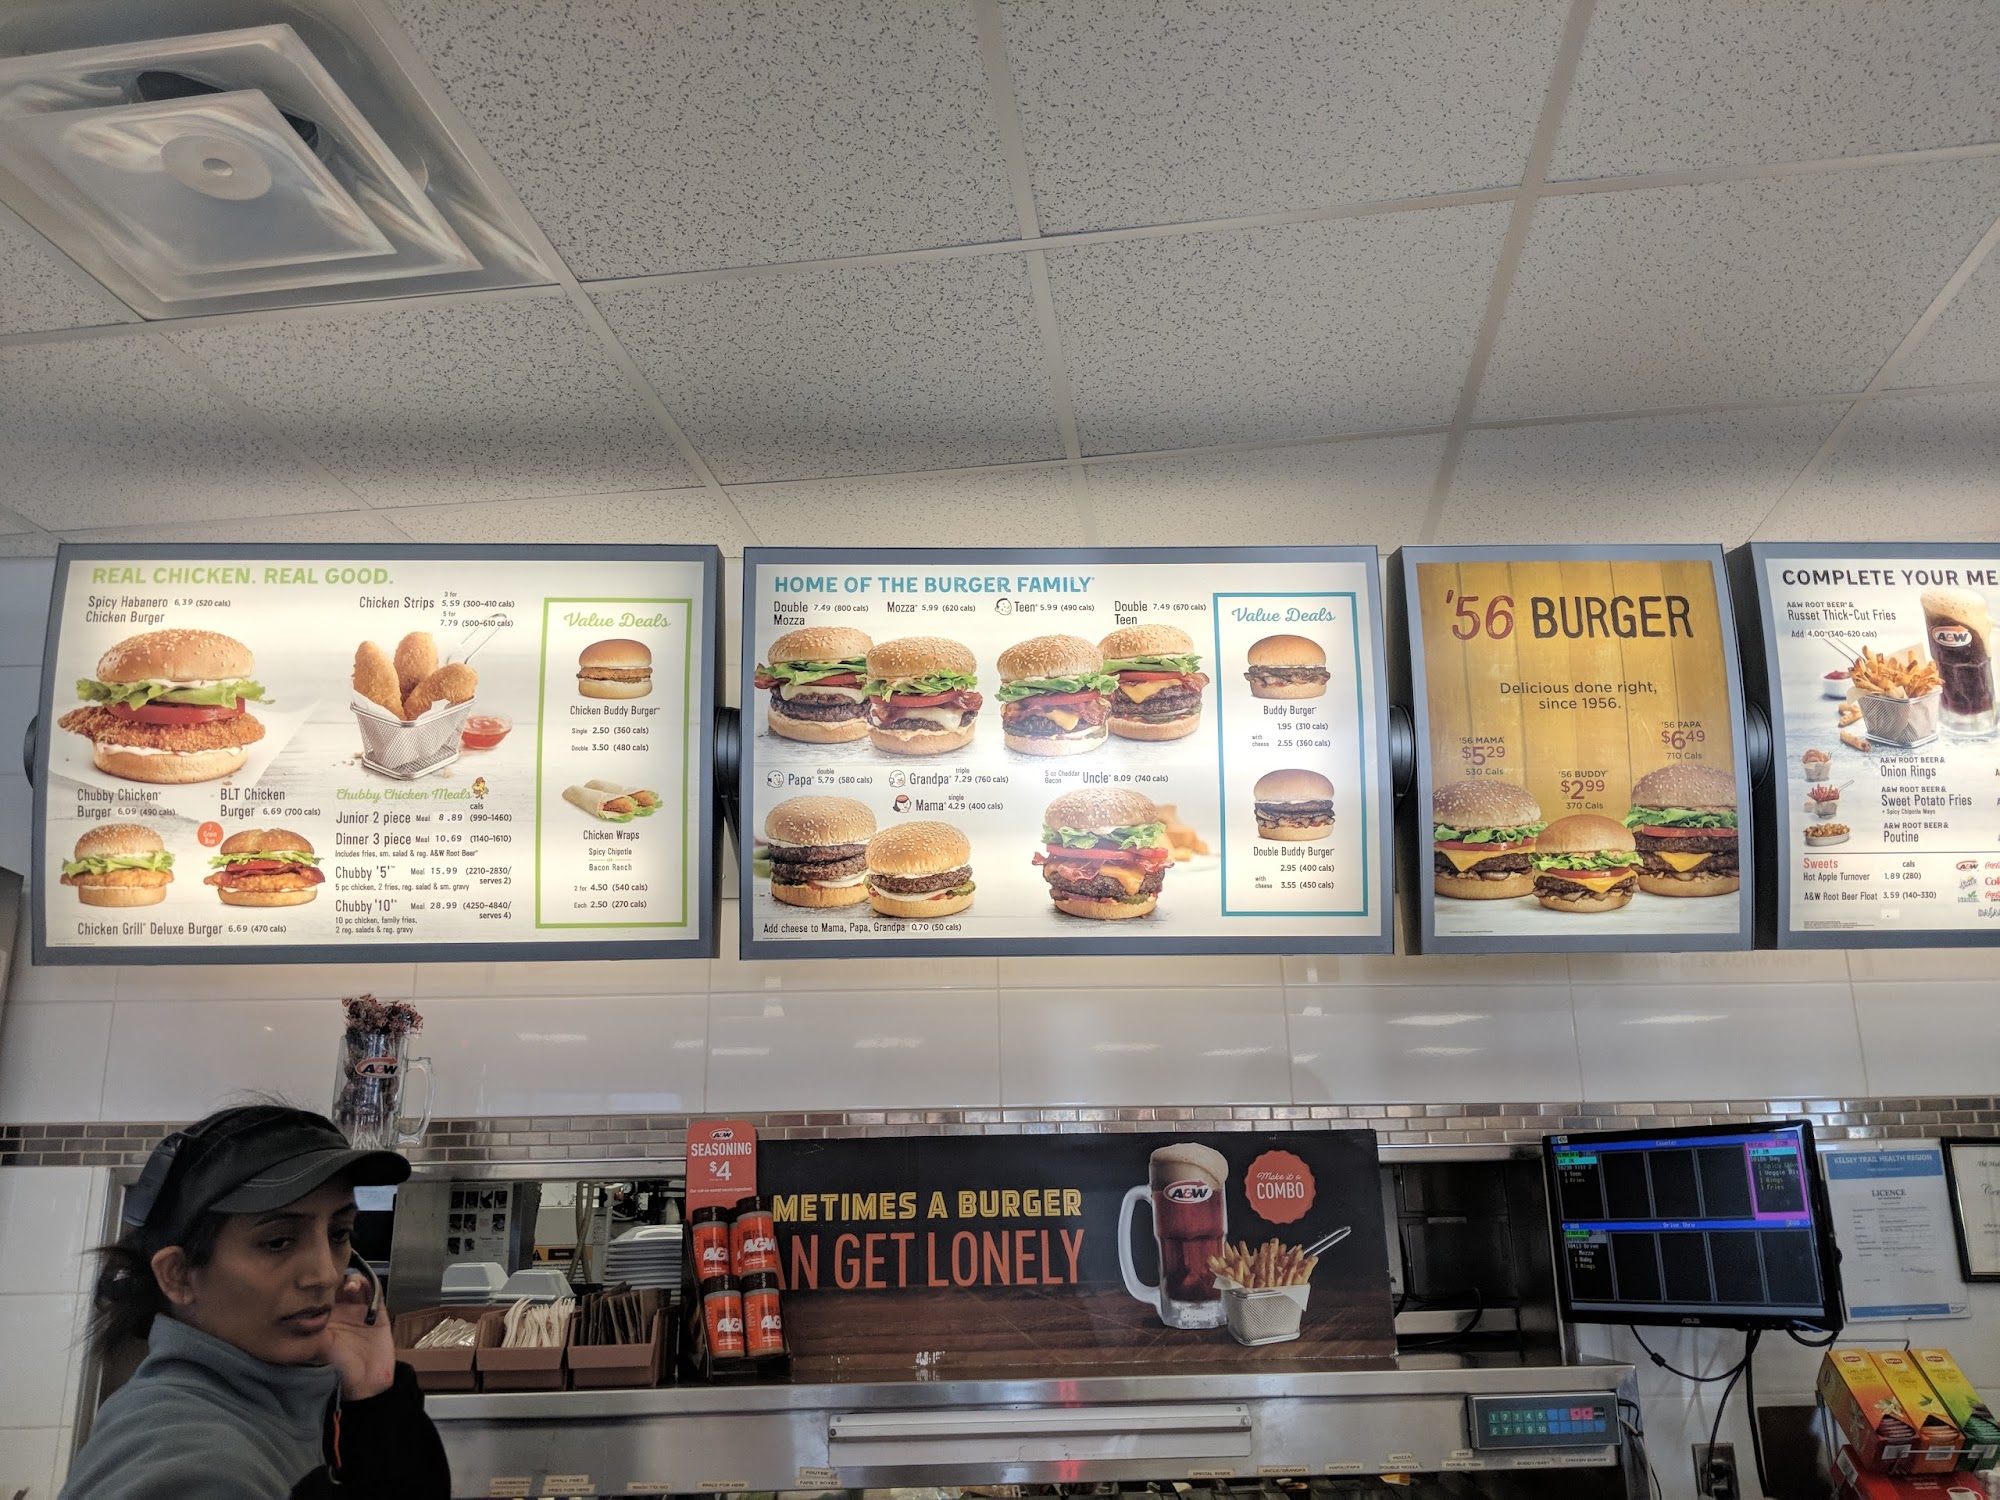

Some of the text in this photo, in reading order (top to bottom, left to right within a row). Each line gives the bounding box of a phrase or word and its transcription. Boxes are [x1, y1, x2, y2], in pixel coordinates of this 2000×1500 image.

[92, 567, 394, 585] REAL CHICKEN. REAL GOOD.
[1782, 569, 1999, 586] COMPLETE YOUR ME
[775, 576, 1091, 593] HOME OF THE BURGER FAMILY
[88, 595, 231, 609] Spicy Habanero 6.39 (520 cals)
[359, 596, 399, 608] Chicken
[403, 596, 435, 610] Strips
[498, 600, 515, 608] cals)
[1114, 601, 1148, 612] Double
[85, 611, 165, 625] Chicken Burger
[563, 612, 671, 627] Value Deals
[1114, 614, 1138, 625] Teen
[1231, 607, 1336, 622] Value Deals
[1445, 589, 1694, 640] '56 BURGER
[1788, 610, 1896, 621] Russet Thick-Cut Fries
[1936, 631, 1968, 642] A&W
[1500, 681, 1657, 696] Delicious done right,
[1539, 698, 1621, 710] since 1956.
[570, 706, 600, 715] Chicken
[604, 706, 628, 717] Buddy
[1263, 705, 1287, 716] Buddy
[1083, 771, 1169, 784] Uncle 8.09 (740 cals)
[1574, 770, 1607, 778] BUDDY
[1880, 765, 1936, 779] Onion Rings
[788, 773, 873, 788] Papa 5.79 (580 cals)
[336, 788, 471, 803] Chubby Chicken Meals
[1881, 794, 1972, 807] Sweet Potato Fries
[1566, 802, 1603, 810] 370 Cals
[336, 833, 369, 845] Dinner
[373, 833, 380, 845] 3
[384, 833, 411, 847] piece
[583, 830, 640, 841] Chicken Wraps
[1884, 831, 1919, 843] Poutine
[588, 848, 632, 856] Spicy Chipotle
[1253, 846, 1279, 856] Double
[1281, 846, 1305, 858] Buddy
[1803, 858, 1915, 869] Sweets cals
[1803, 873, 1815, 881] Hot
[1817, 873, 1838, 882] Apple
[1840, 873, 1870, 881] Turnover
[1902, 872, 1922, 881] (280)
[1299, 881, 1317, 889] (450
[1318, 881, 1334, 889] cals)
[503, 912, 512, 920] 4)
[77, 923, 287, 937] Chicken Grill Deluxe Burger 6.69 (470 cals)
[763, 922, 962, 933] Add cheese to Mama, Papa, Grandpa 0.70 (50 cals)
[360, 1062, 398, 1074] A&W
[691, 1142, 752, 1157] SEASONING
[709, 1161, 732, 1181] $4
[1257, 1172, 1285, 1180] Make
[1170, 1188, 1209, 1199] A&W
[1256, 1183, 1305, 1199] COMBO
[1872, 1189, 1907, 1197] LICENCE
[927, 1191, 949, 1219] A
[958, 1188, 1082, 1218] BURGER
[834, 1232, 916, 1288] GET
[927, 1228, 1085, 1287] LONELY
